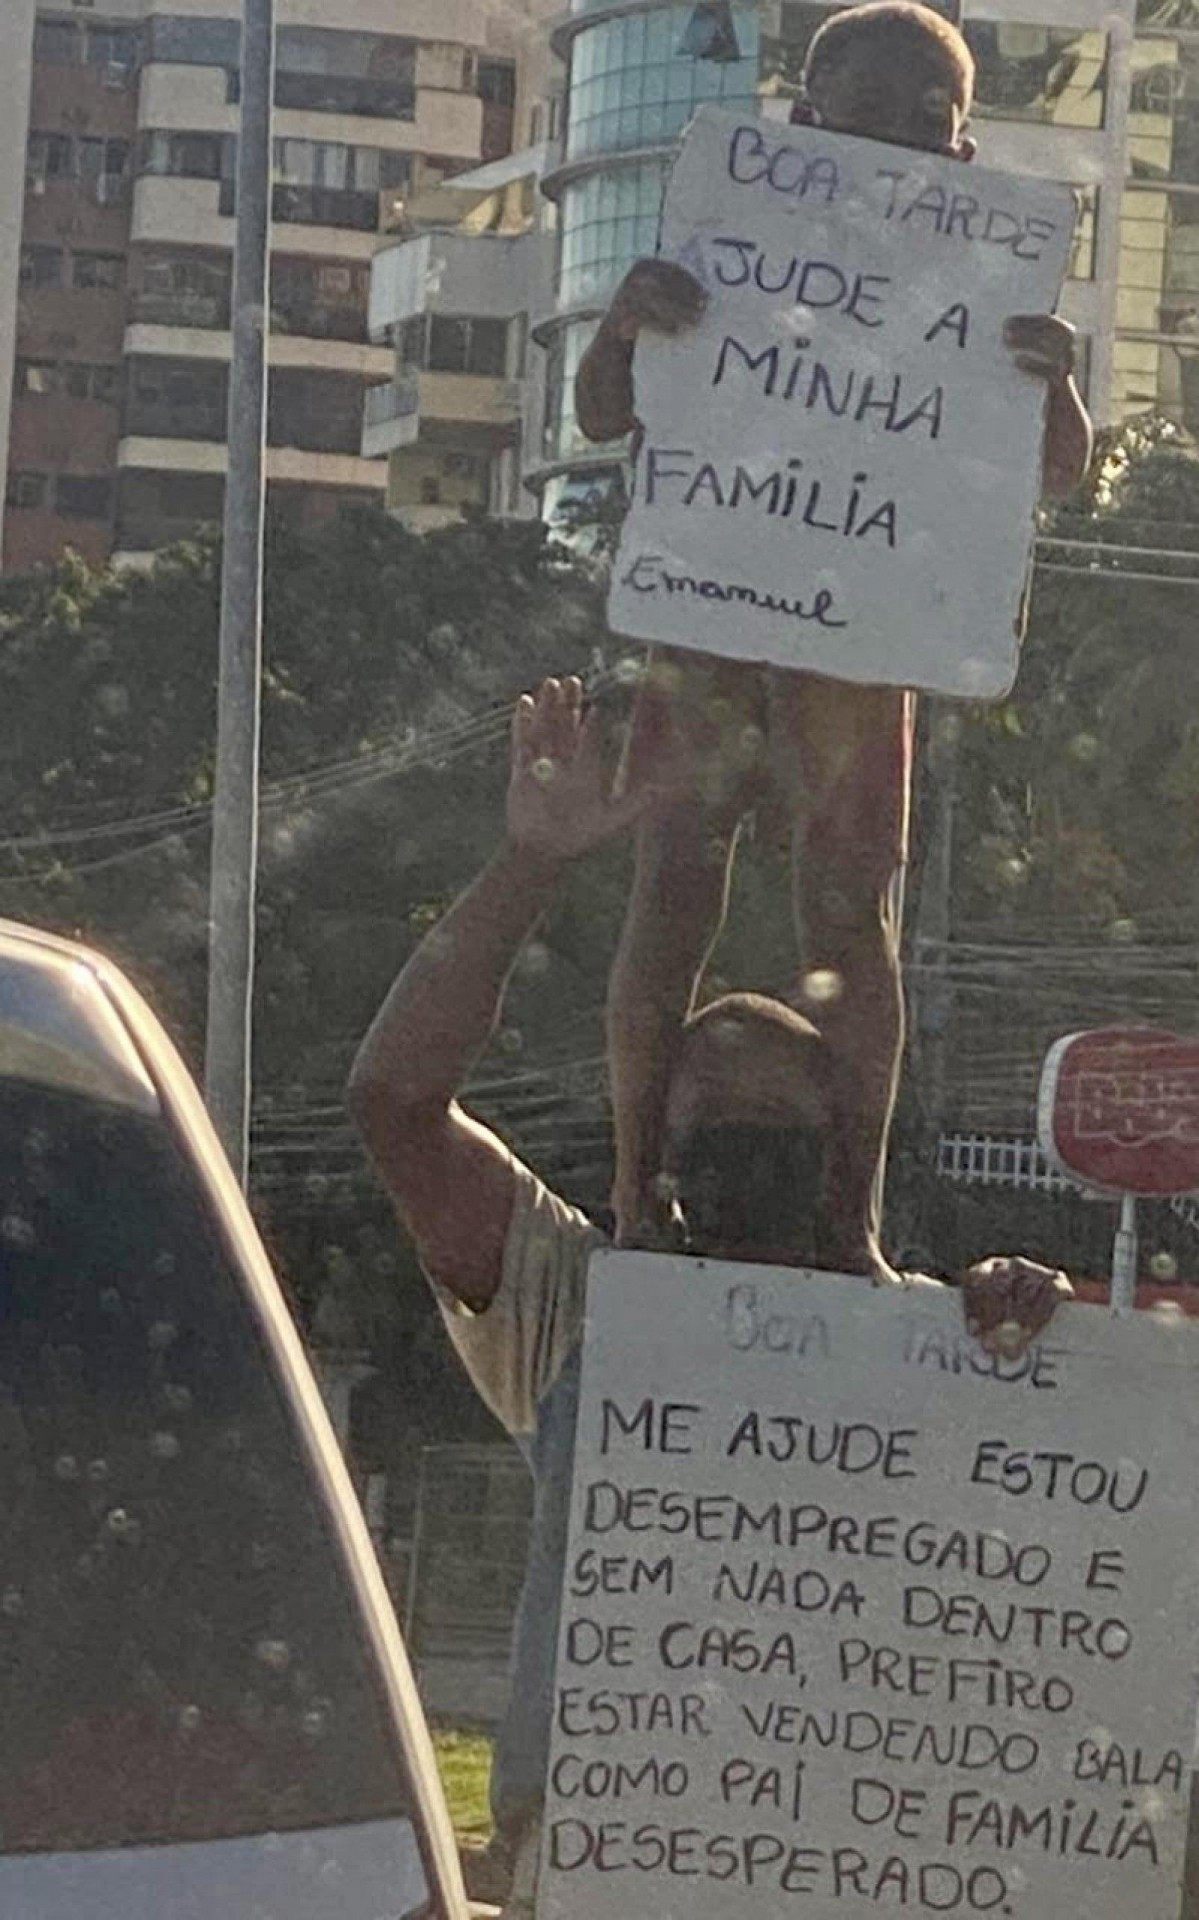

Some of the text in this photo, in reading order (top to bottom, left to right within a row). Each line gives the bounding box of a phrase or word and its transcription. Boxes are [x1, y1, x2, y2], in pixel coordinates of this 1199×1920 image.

[729, 126, 1055, 260] BOA TARDE
[925, 303, 969, 348] A
[601, 1399, 1149, 1513] ME AJUDE ESTOU
[583, 1481, 1126, 1592] DESEMPREGADO E
[567, 1618, 634, 1668] DE
[659, 1622, 806, 1688] CASA,
[569, 1549, 1132, 1660] SEM NADA DENTRO
[557, 1687, 1185, 1791] ESTAR VENDENDO BALA
[551, 1753, 688, 1801] COMO
[850, 1778, 927, 1837] DE
[548, 1817, 1014, 1916] DESESPERADO.
